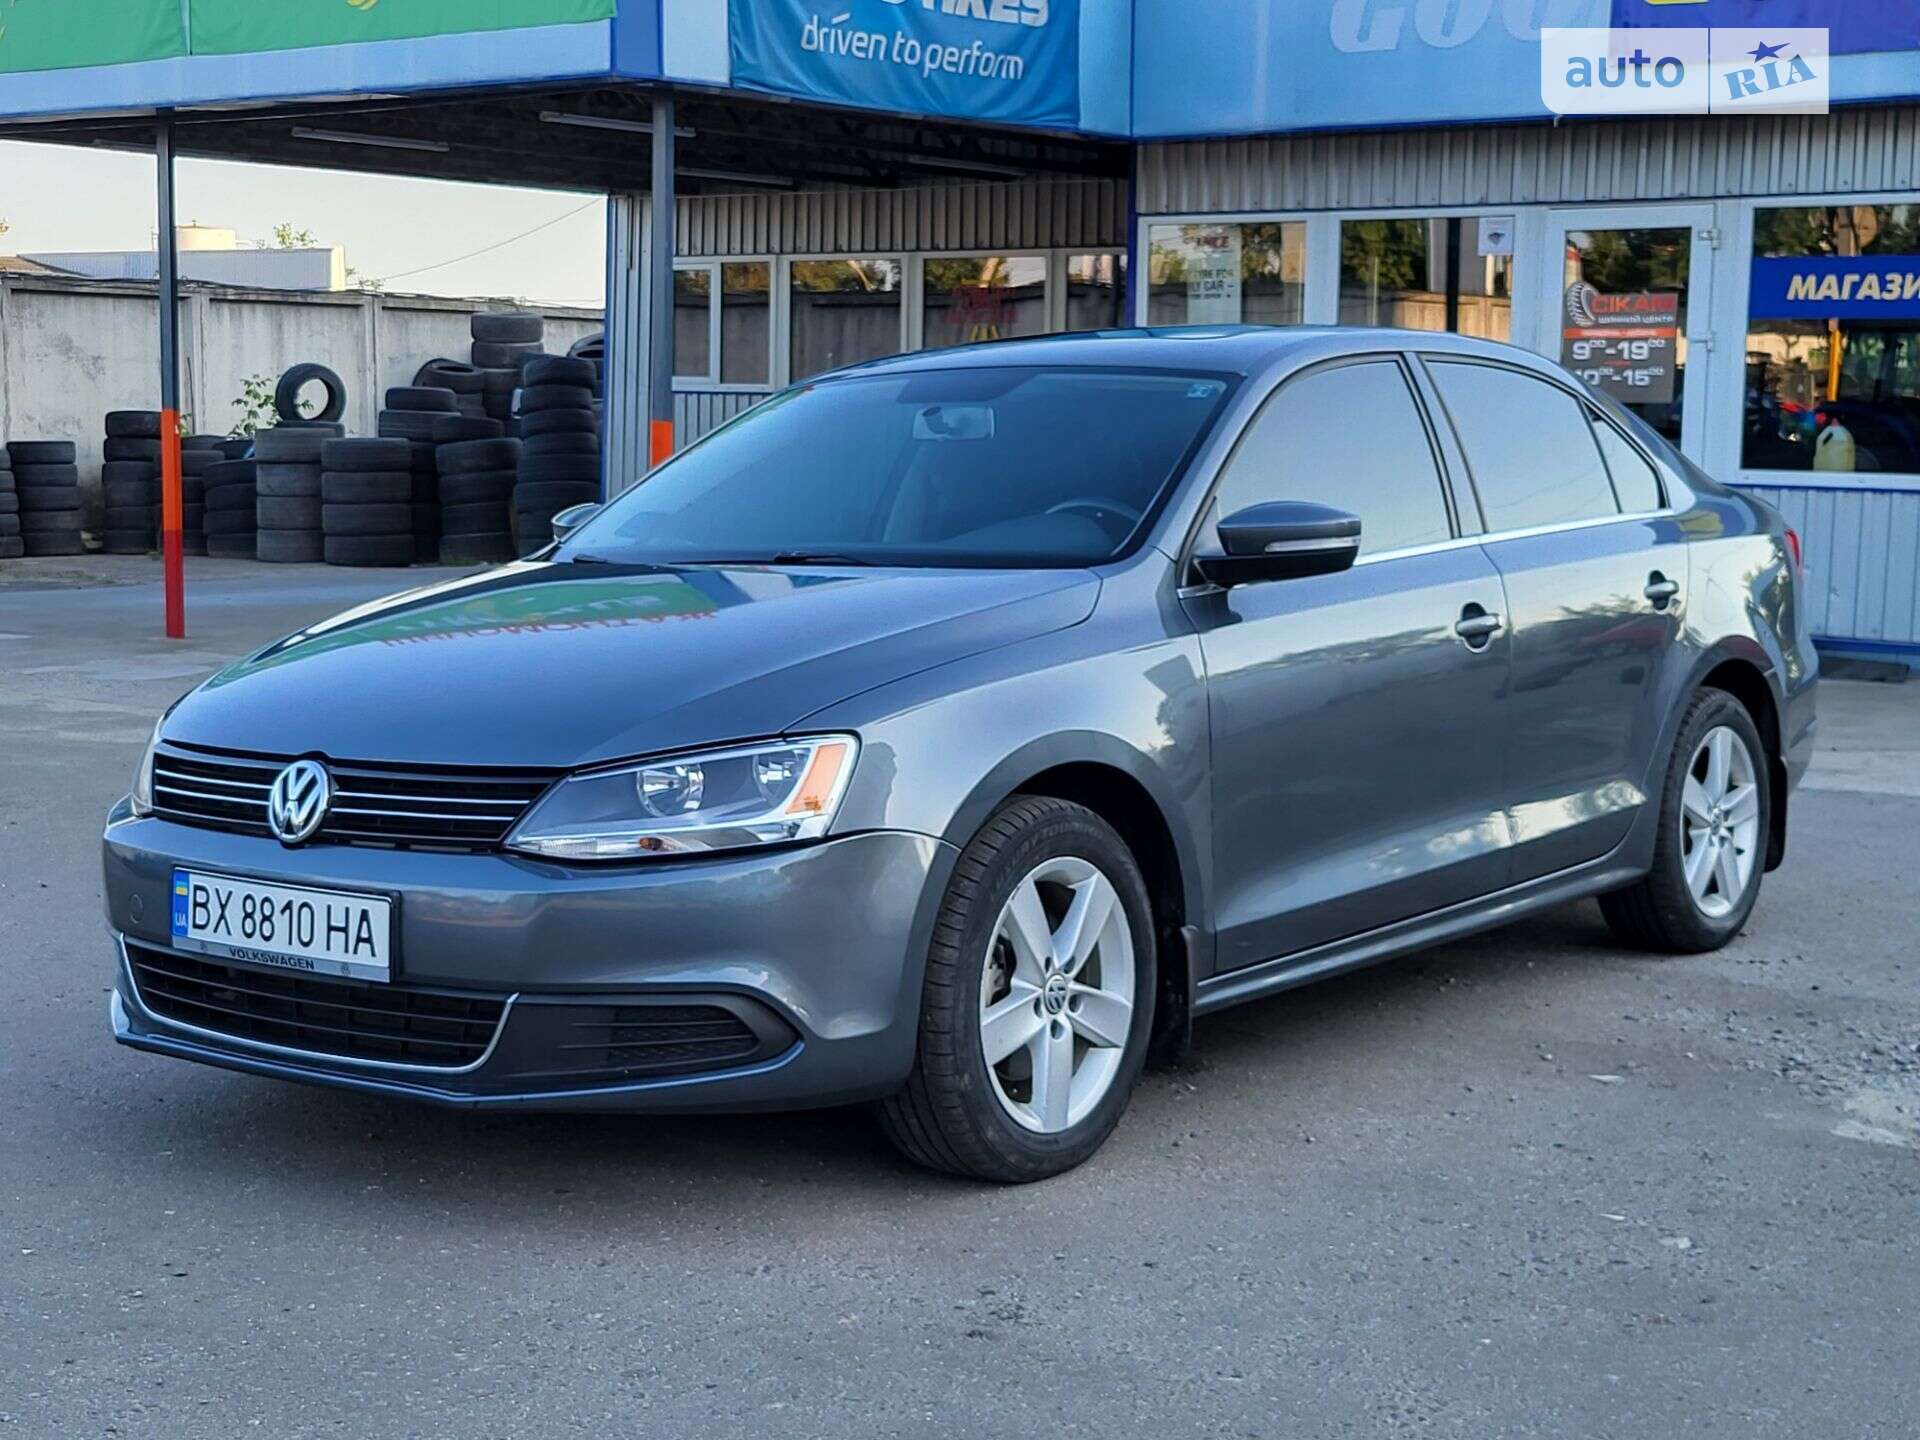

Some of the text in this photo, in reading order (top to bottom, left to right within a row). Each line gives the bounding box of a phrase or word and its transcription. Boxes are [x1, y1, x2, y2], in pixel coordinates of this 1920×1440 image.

[892, 31, 921, 66] to
[923, 41, 1024, 79] perform
[1786, 272, 1920, 301] МАГАЗИ
[175, 911, 188, 929] UA
[192, 884, 377, 958] BX 8810 HA
[229, 948, 315, 970] VOLKSWAGEN
